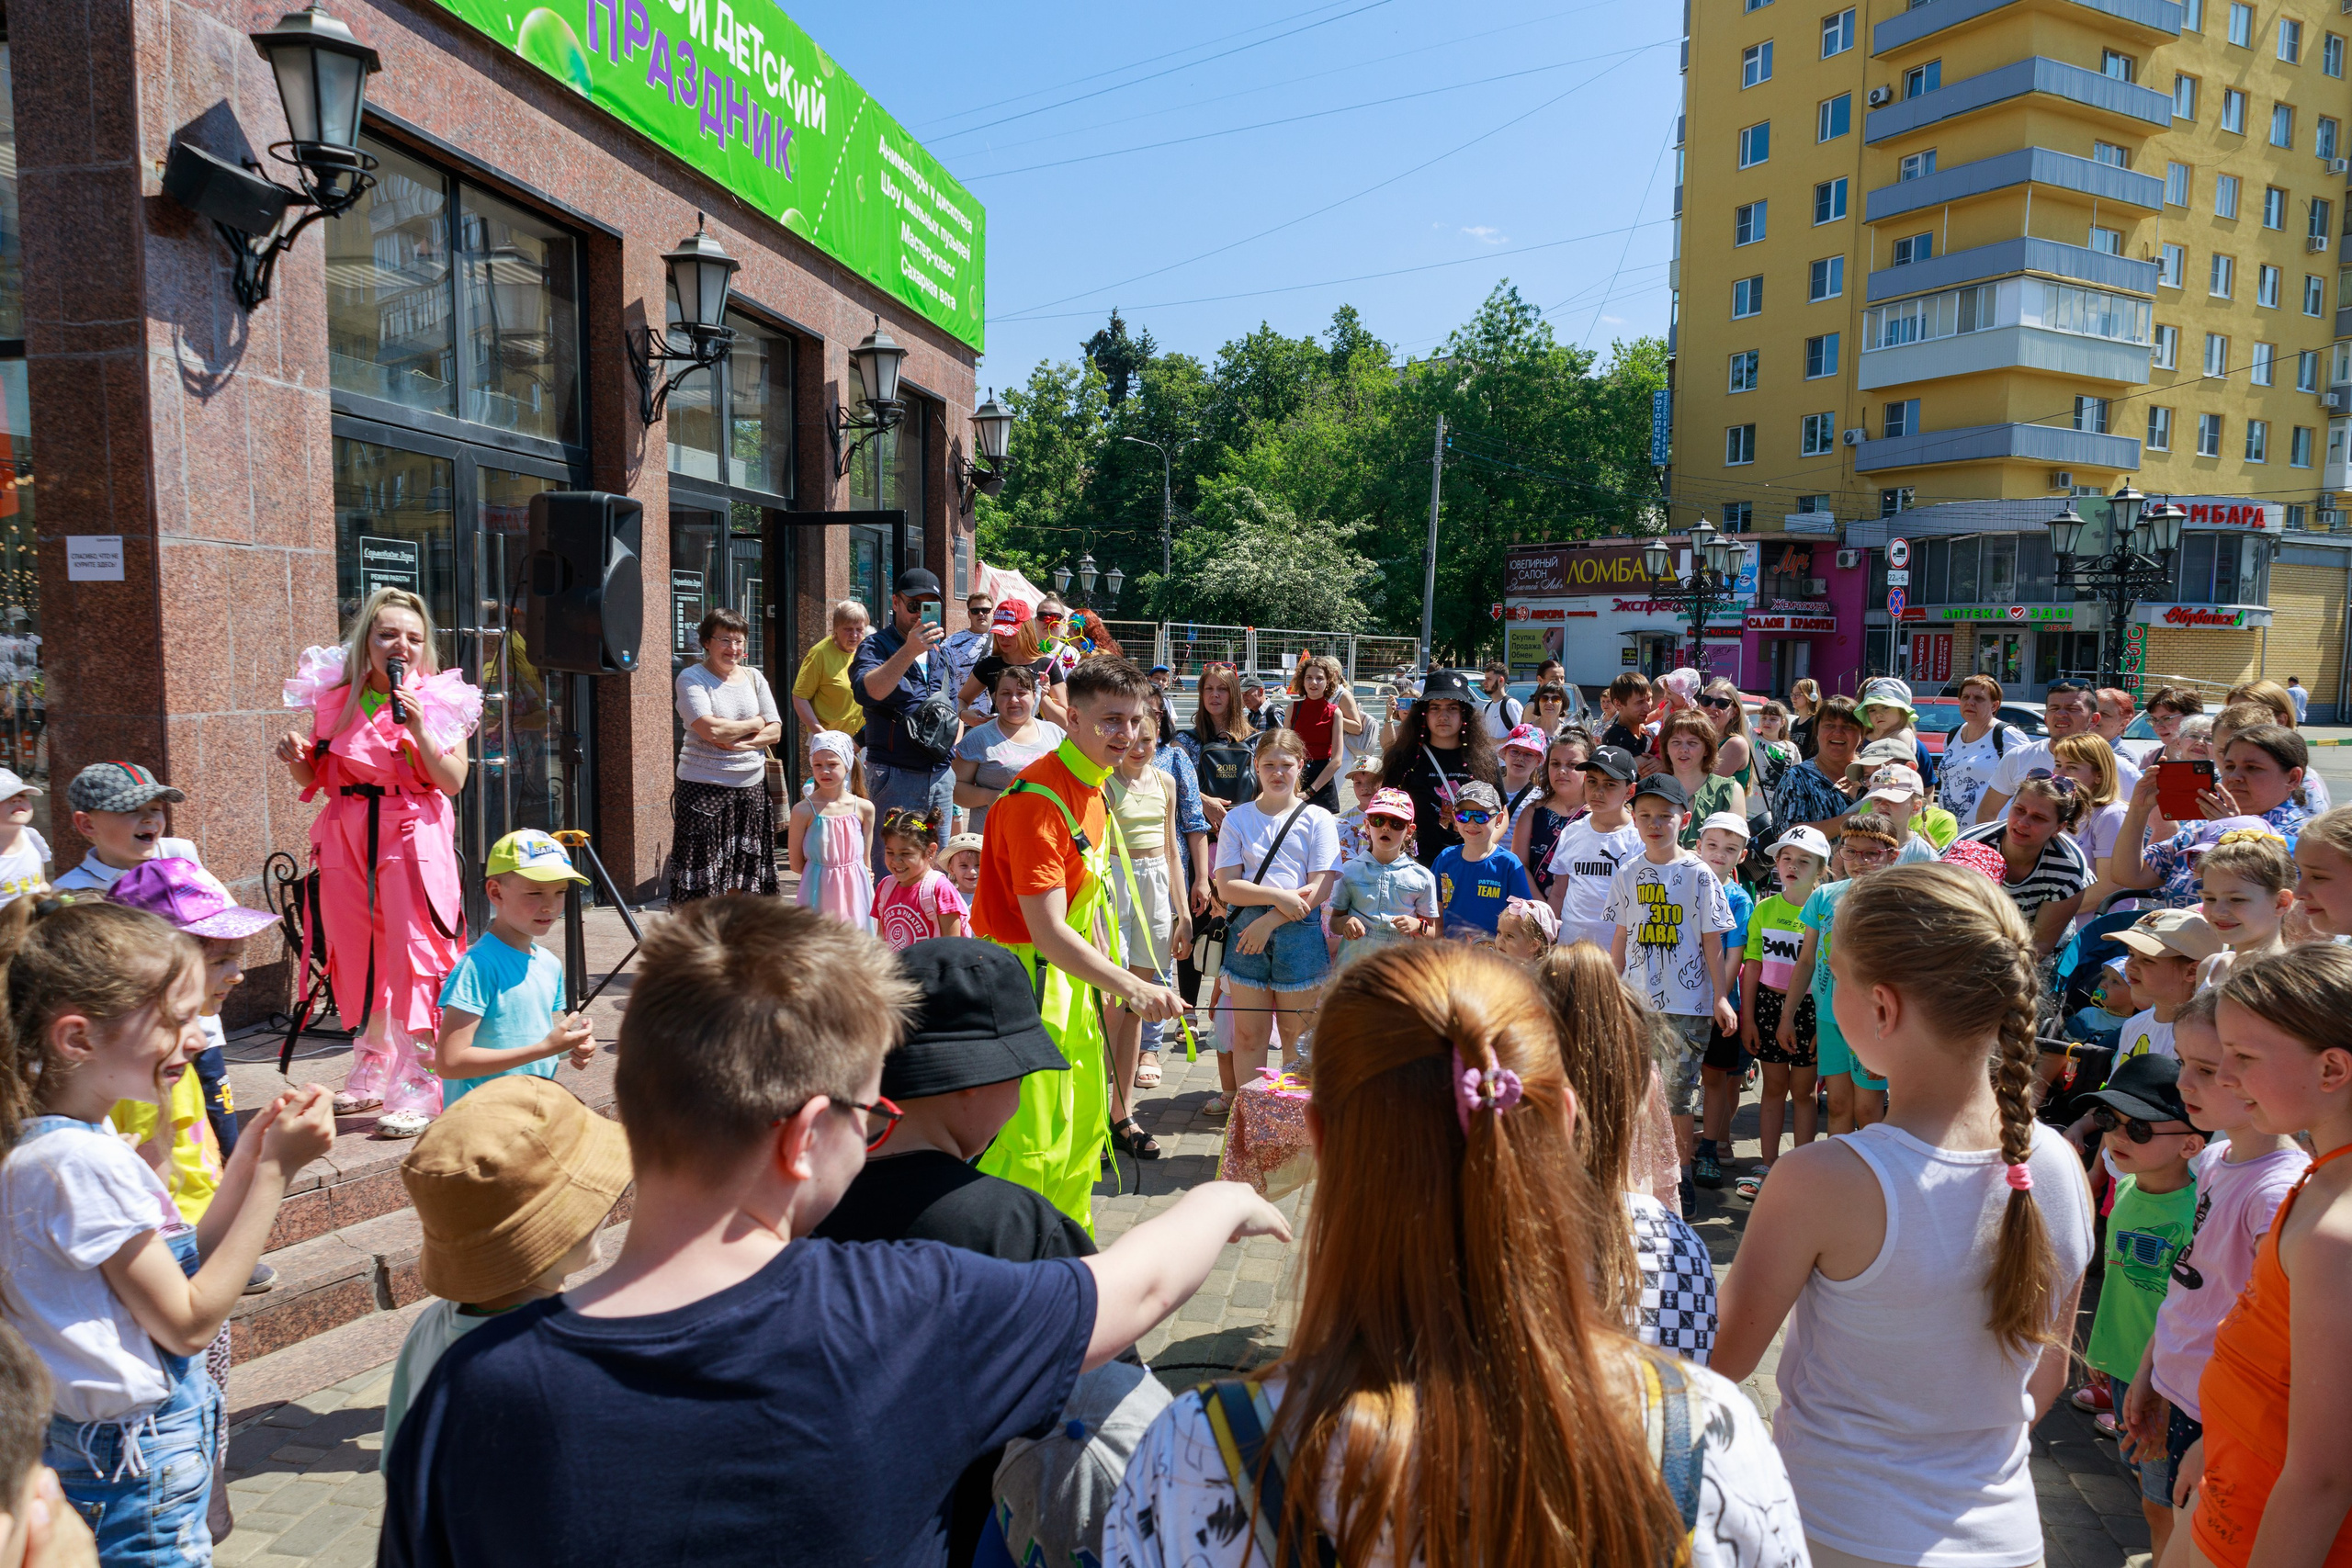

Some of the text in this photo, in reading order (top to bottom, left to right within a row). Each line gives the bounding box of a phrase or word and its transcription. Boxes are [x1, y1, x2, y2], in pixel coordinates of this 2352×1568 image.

[713, 0, 826, 136] ДЕТСКИЙ
[587, 0, 795, 184] ПРАЗДНИК
[878, 134, 929, 197] Аниматоры
[935, 191, 973, 235] дискотека
[880, 169, 971, 263] Шоу мыльных пузырей
[900, 220, 956, 280] Мастер-класс
[900, 254, 956, 311] Сахарная вата
[1654, 391, 1663, 459] ФОТОПЕЧАТЬ
[2153, 503, 2267, 529] МБАРД
[1509, 556, 1559, 570] ЮВЕЛИРНЫЙ
[1566, 556, 1678, 584] ЛОМБАД
[1773, 544, 1809, 580] Луч
[1518, 570, 1548, 580] САЛОН
[1531, 609, 1565, 619] АВРОРА
[1747, 617, 1835, 630] САЛОН КРАСОТЫ
[1942, 608, 2006, 619] АПТЕКА
[1511, 633, 1536, 642] Скупка
[2043, 624, 2073, 632] ОБУВ
[1511, 643, 1542, 651] Продажа
[1216, 763, 1238, 772] 2018
[1574, 862, 1612, 876] PUMA
[1477, 885, 1501, 898] TEAM
[1478, 879, 1501, 887] PATROL
[1636, 883, 1667, 905] ПОЛ
[902, 909, 924, 933] PIRATES
[1650, 903, 1683, 925] ЭТО
[1637, 922, 1679, 944] ЛАВА
